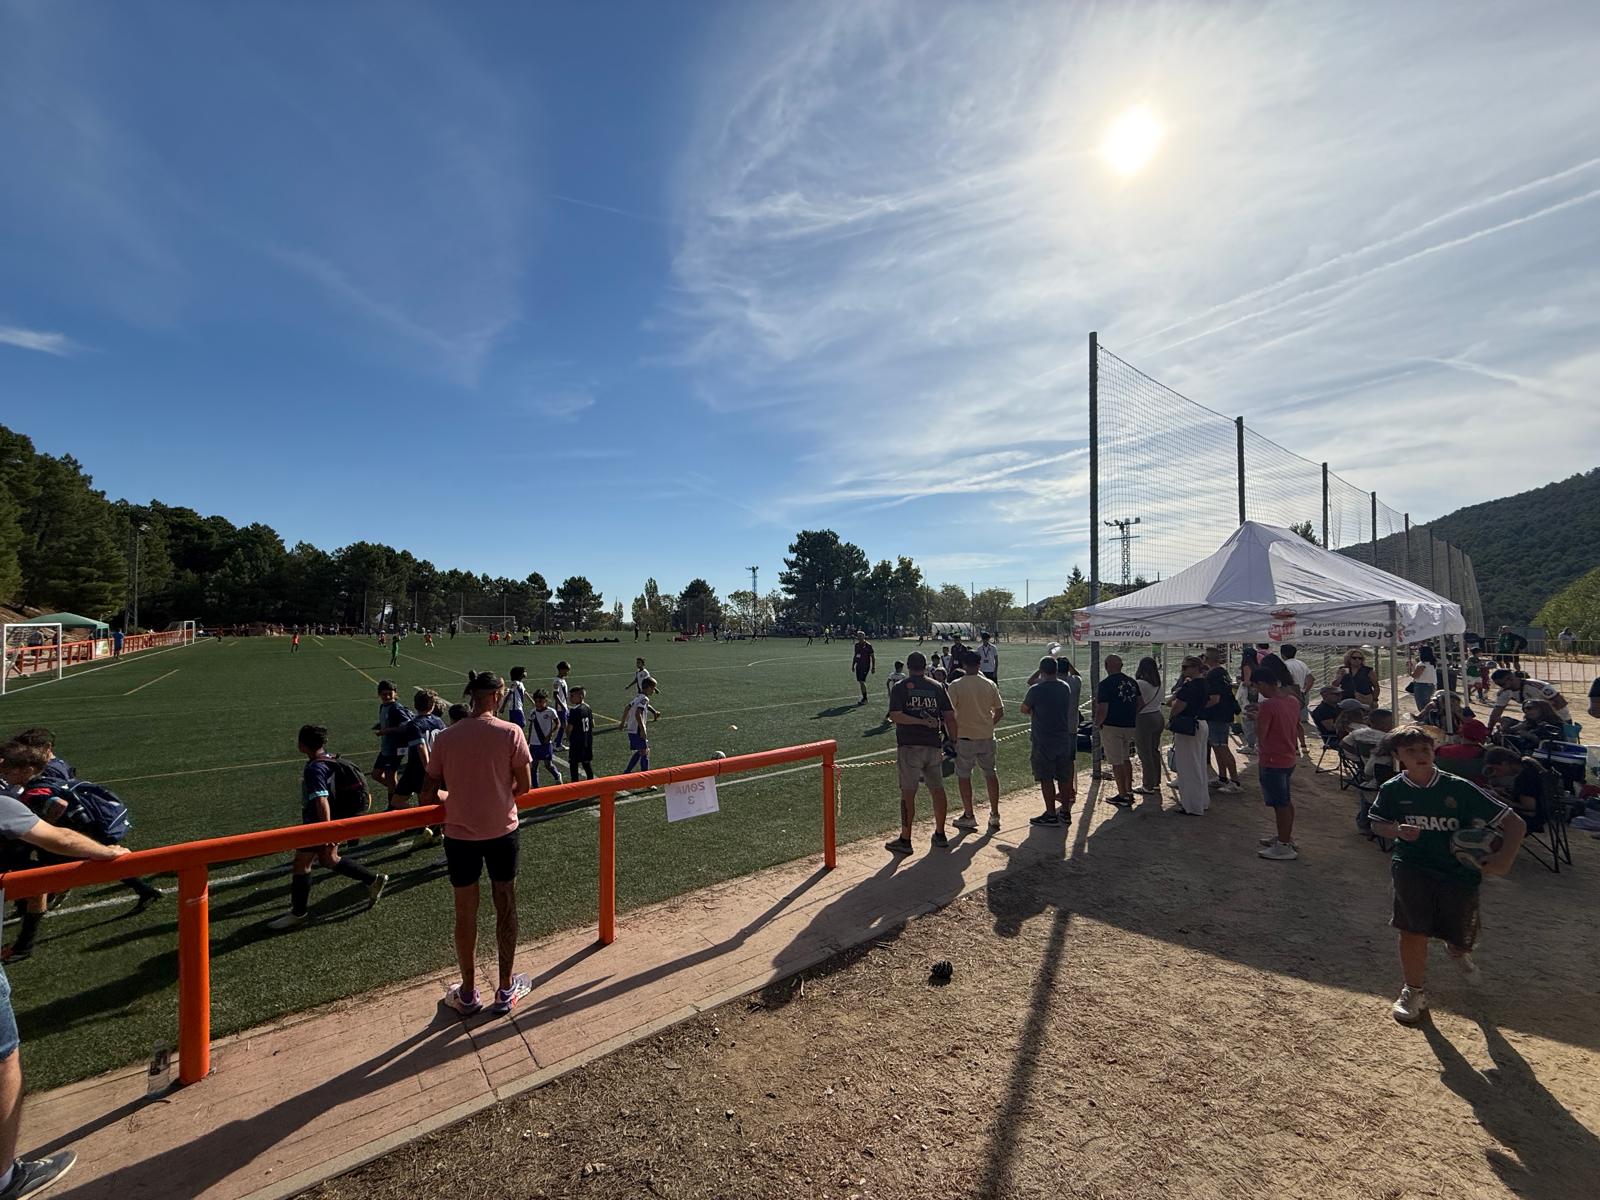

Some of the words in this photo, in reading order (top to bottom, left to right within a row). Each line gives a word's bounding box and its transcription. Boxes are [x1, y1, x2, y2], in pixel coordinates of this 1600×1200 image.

[1094, 629, 1152, 639] Bustarviejo
[1303, 627, 1394, 640] Bustarviejo
[911, 696, 938, 708] PLAYA
[582, 717, 590, 732] 13
